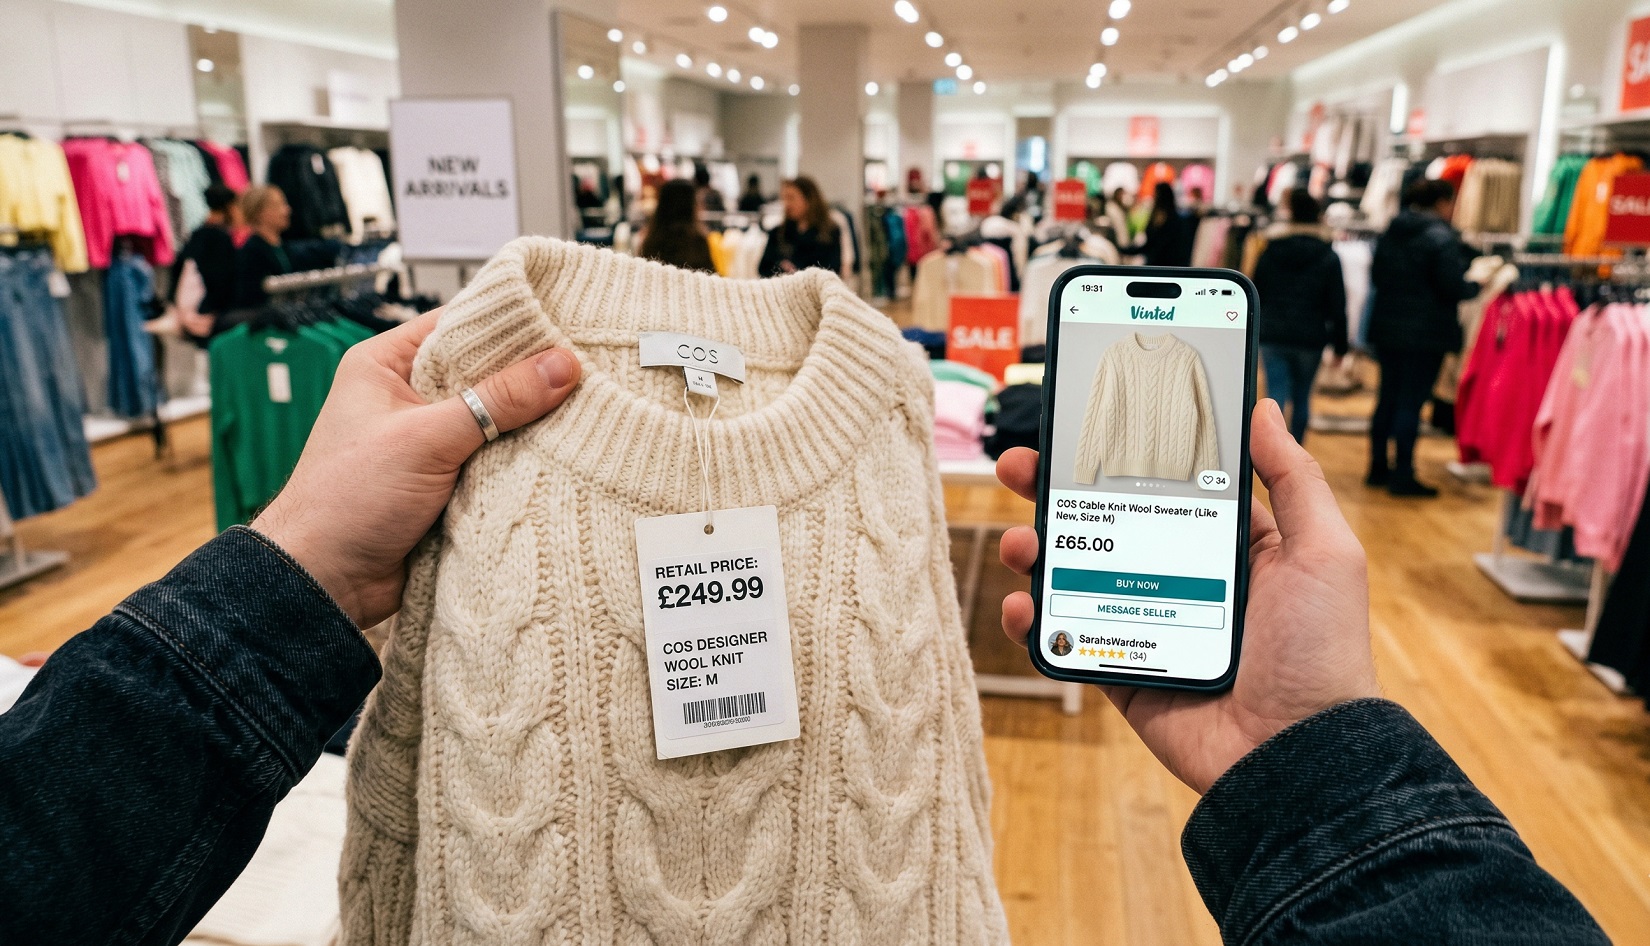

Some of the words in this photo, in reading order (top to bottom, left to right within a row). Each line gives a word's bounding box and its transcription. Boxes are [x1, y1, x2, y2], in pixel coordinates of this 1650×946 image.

[428, 156, 478, 174] NEW
[404, 180, 509, 198] ARRIVALS
[1610, 195, 1650, 216] SAL
[1081, 284, 1103, 293] 19:31
[1130, 305, 1176, 321] Vinted
[952, 326, 1014, 350] SALE
[676, 344, 719, 364] COS
[1215, 477, 1226, 485] 34
[1056, 499, 1077, 509] COS
[1079, 500, 1106, 511] Cable
[1108, 502, 1127, 512] Knit
[1128, 504, 1152, 514] Wool
[1154, 506, 1192, 516] Sweater
[1194, 508, 1218, 518] (Like
[1055, 511, 1079, 522] New,
[1080, 513, 1100, 523] Size
[1103, 514, 1116, 525] M)
[1055, 535, 1114, 552] £65.00
[655, 562, 707, 579] RETAIL
[710, 557, 758, 573] PRICE:
[658, 576, 764, 609] £249.99
[1116, 579, 1135, 589] BUY
[1137, 581, 1160, 590] NOW
[1097, 604, 1141, 616] MESSAGE
[1143, 608, 1177, 619] SELLER
[663, 640, 693, 655] COS
[697, 631, 768, 651] DESIGNER
[1079, 634, 1157, 649] SarahsWardrobe
[664, 656, 708, 673] WOOL
[711, 652, 744, 667] KNIT
[1129, 651, 1147, 662] (34)
[666, 676, 702, 691] SIZE:
[705, 673, 718, 686] M
